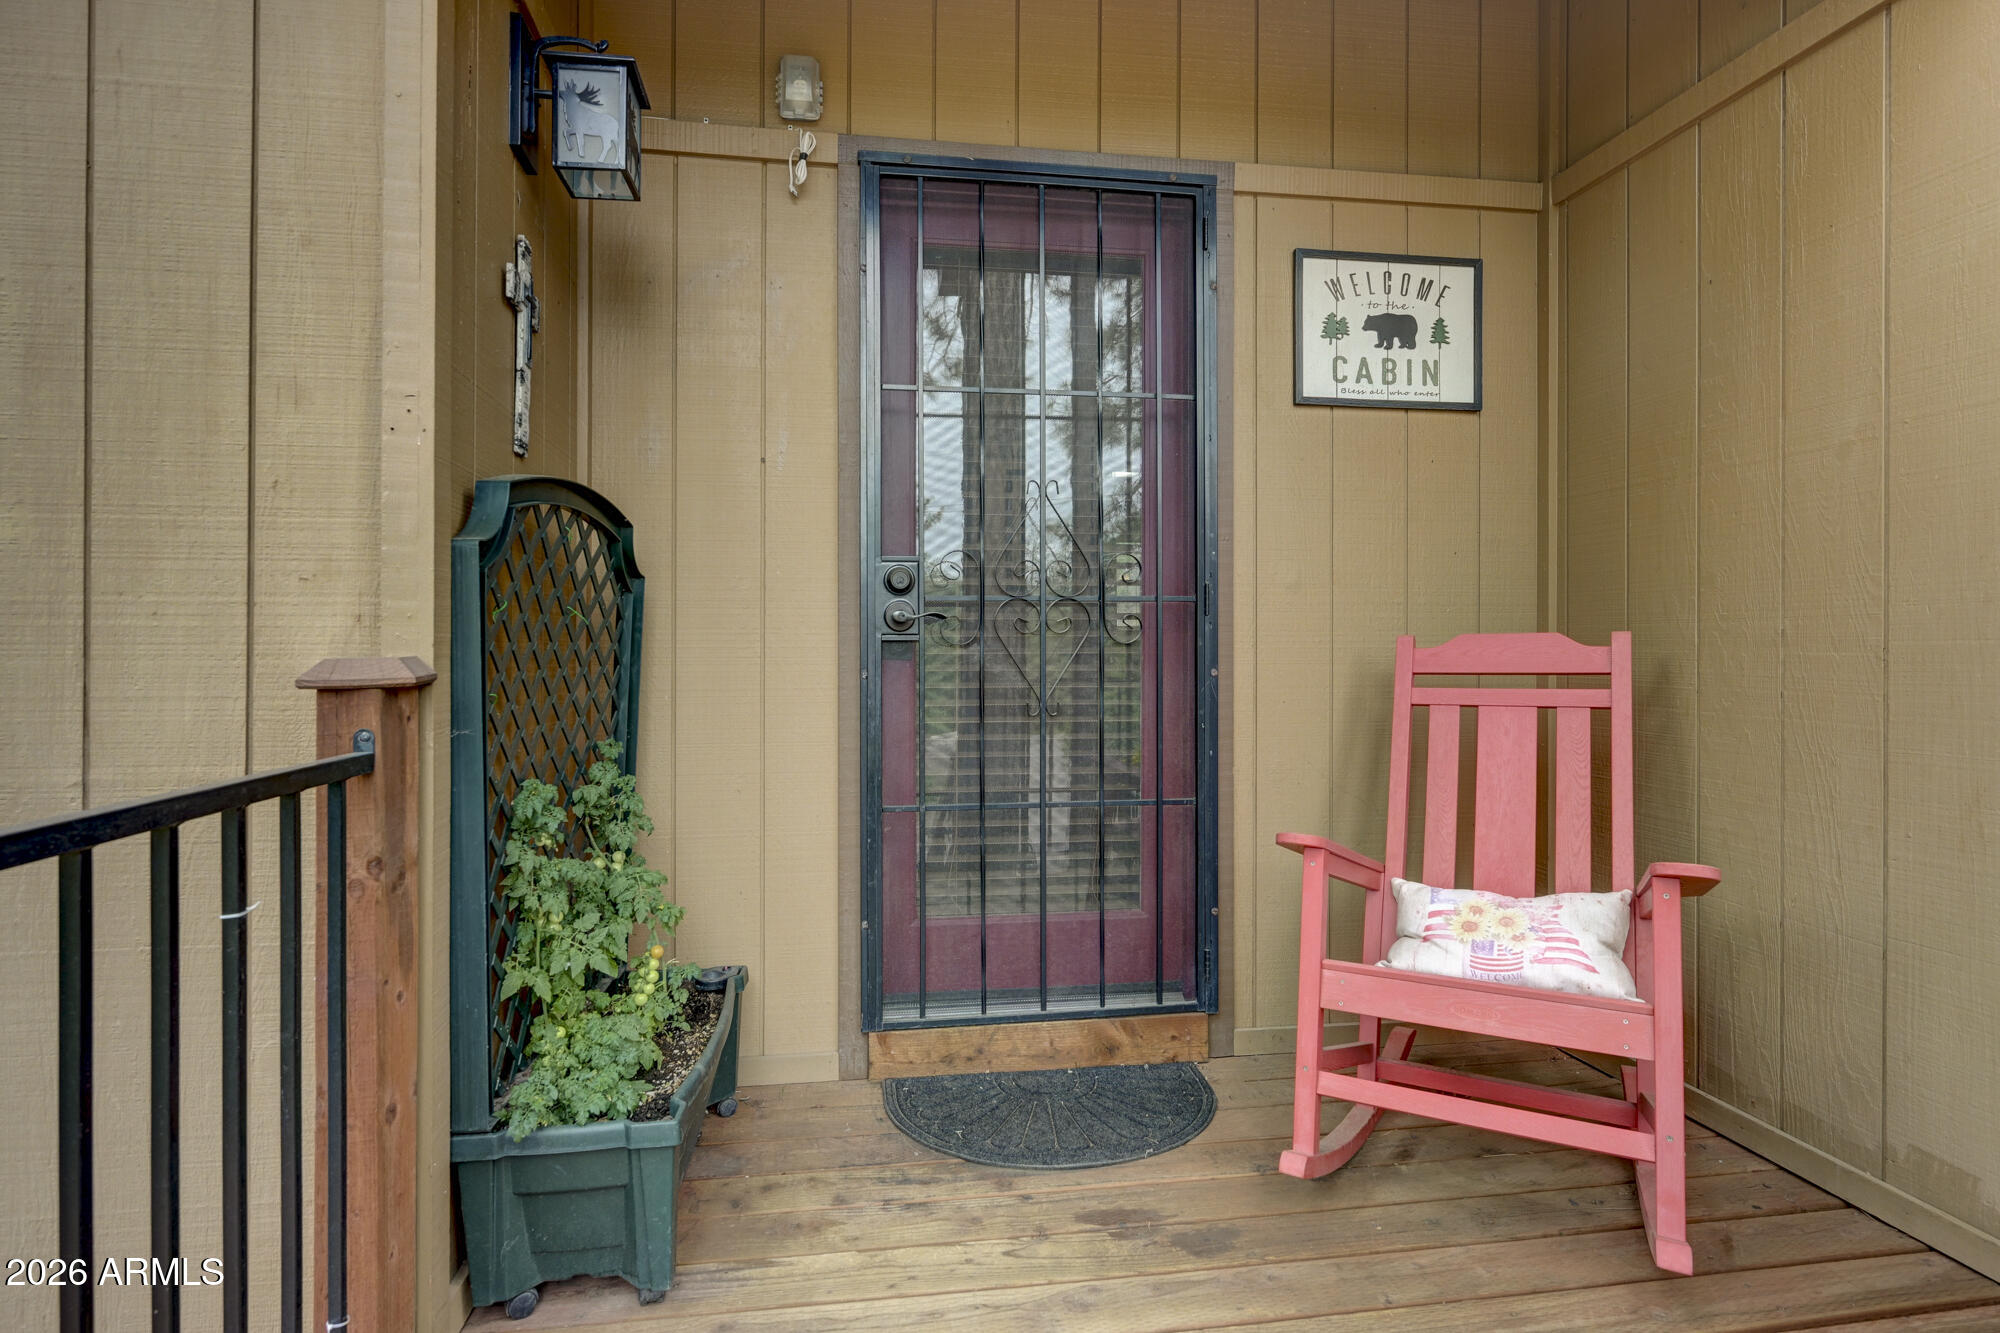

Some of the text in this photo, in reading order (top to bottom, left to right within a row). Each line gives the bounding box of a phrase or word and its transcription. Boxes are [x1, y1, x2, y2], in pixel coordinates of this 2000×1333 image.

[1324, 270, 1452, 308] WELCOME
[1367, 300, 1410, 311] to the
[1332, 355, 1439, 387] CABIN
[1340, 387, 1366, 395] Bless
[1389, 389, 1410, 397] who
[1413, 390, 1440, 398] enter
